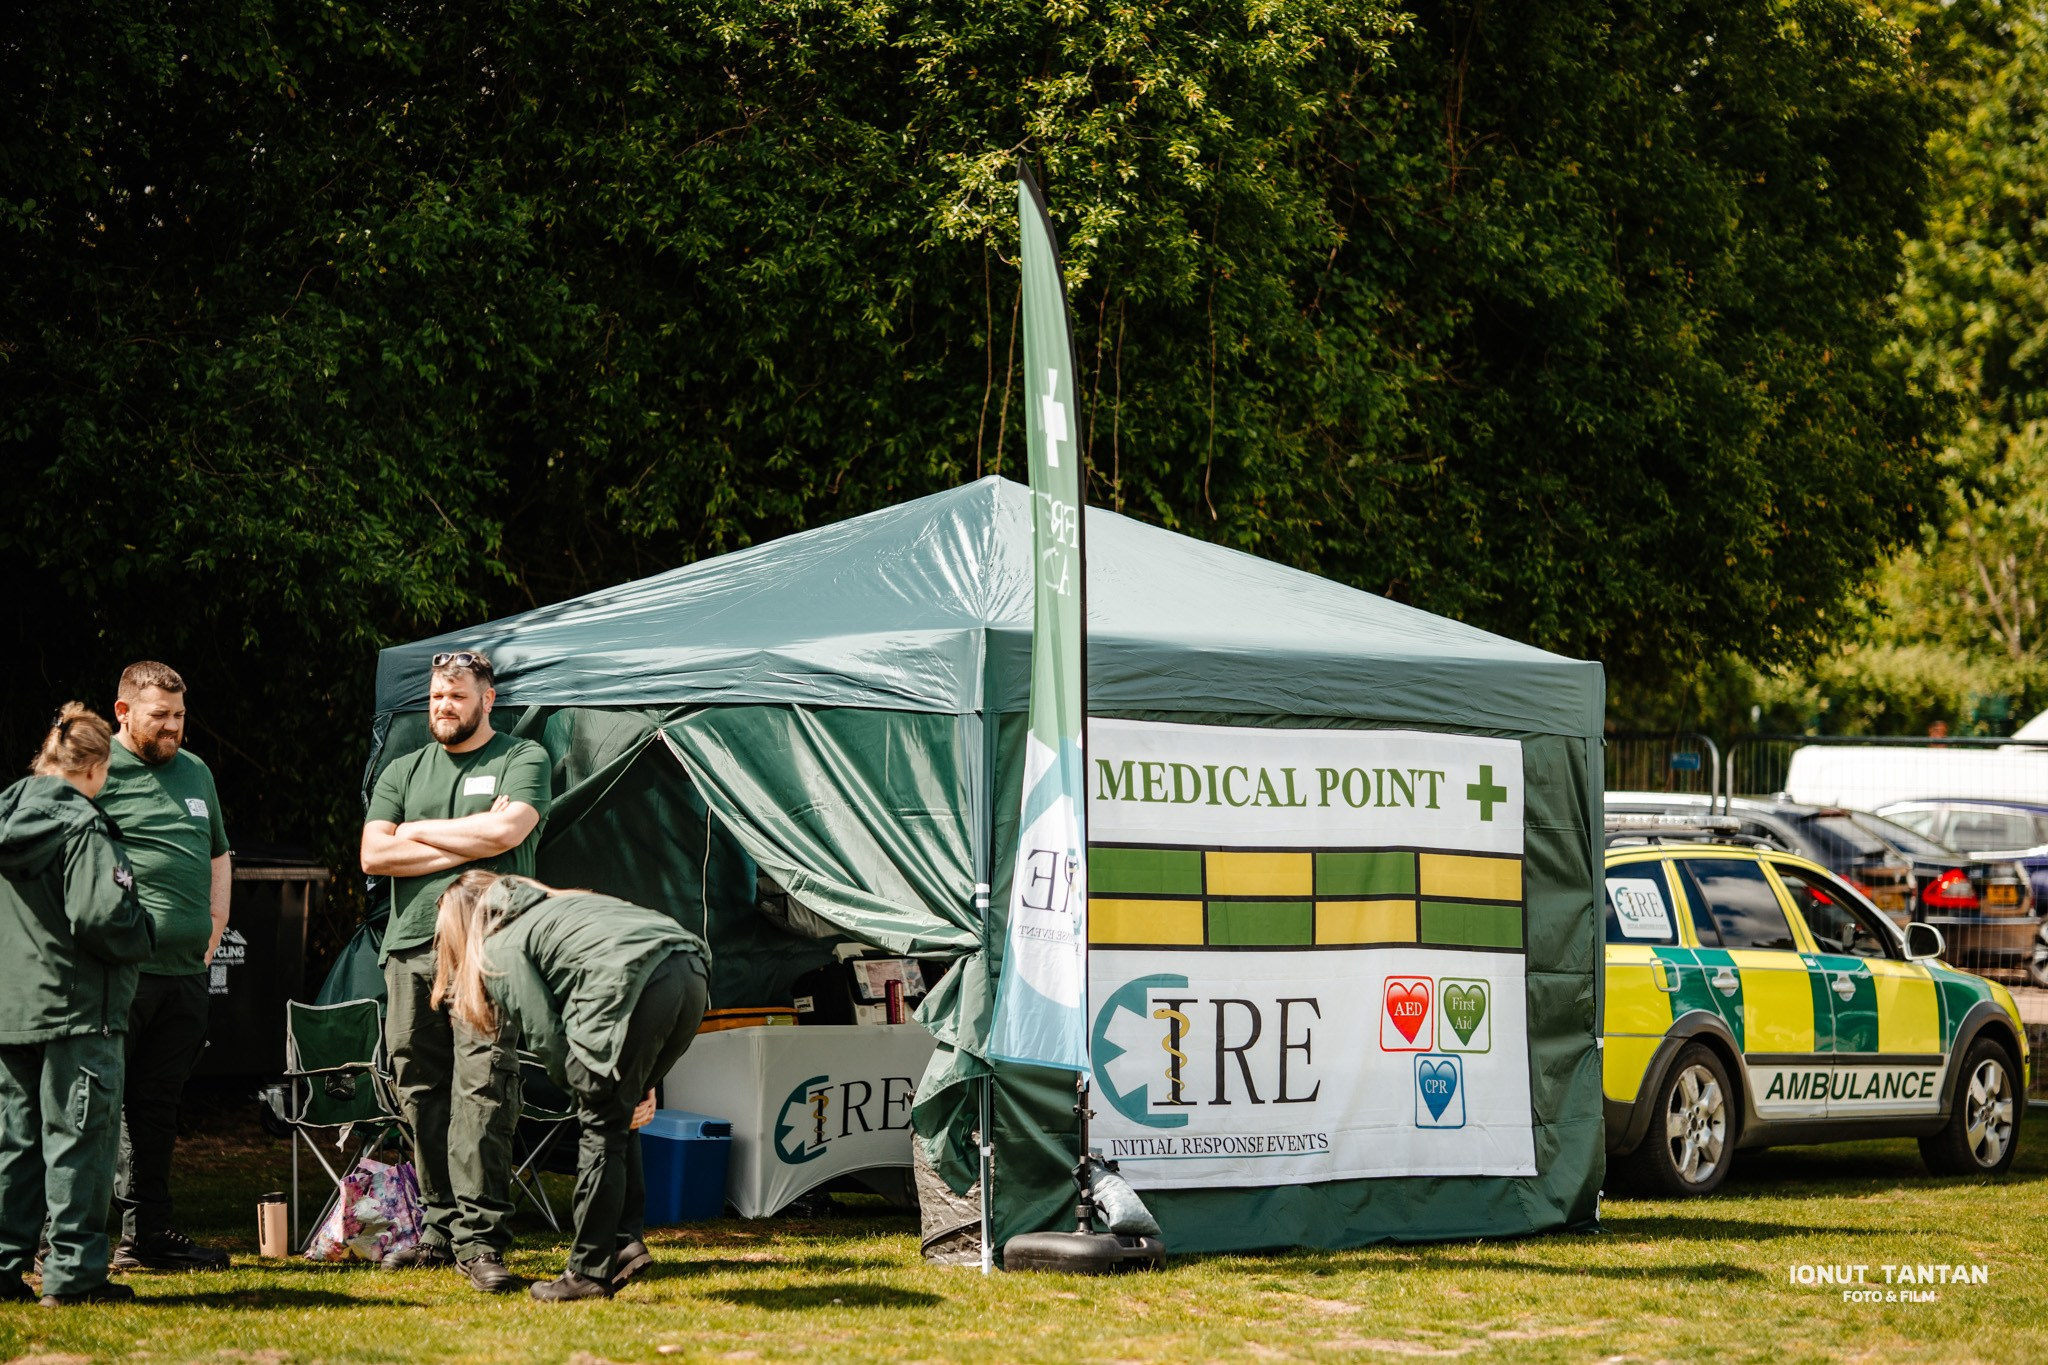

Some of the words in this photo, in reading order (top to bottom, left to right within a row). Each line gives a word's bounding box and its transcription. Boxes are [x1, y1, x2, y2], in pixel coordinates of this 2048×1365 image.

[1095, 758, 1307, 808] MEDICAL
[1315, 767, 1445, 810] POINT
[1622, 891, 1664, 918] IRE
[1394, 1001, 1422, 1017] AED
[1451, 996, 1476, 1013] First
[1455, 1015, 1473, 1030] Aid
[1152, 997, 1321, 1106] IRE
[1424, 1078, 1448, 1095] CPR
[1765, 1071, 1936, 1100] AMBULANCE
[807, 1076, 914, 1152] IRE
[1111, 1138, 1177, 1156] INITIAL
[1182, 1136, 1265, 1155] RESPONSE
[1267, 1133, 1329, 1153] EVENTS
